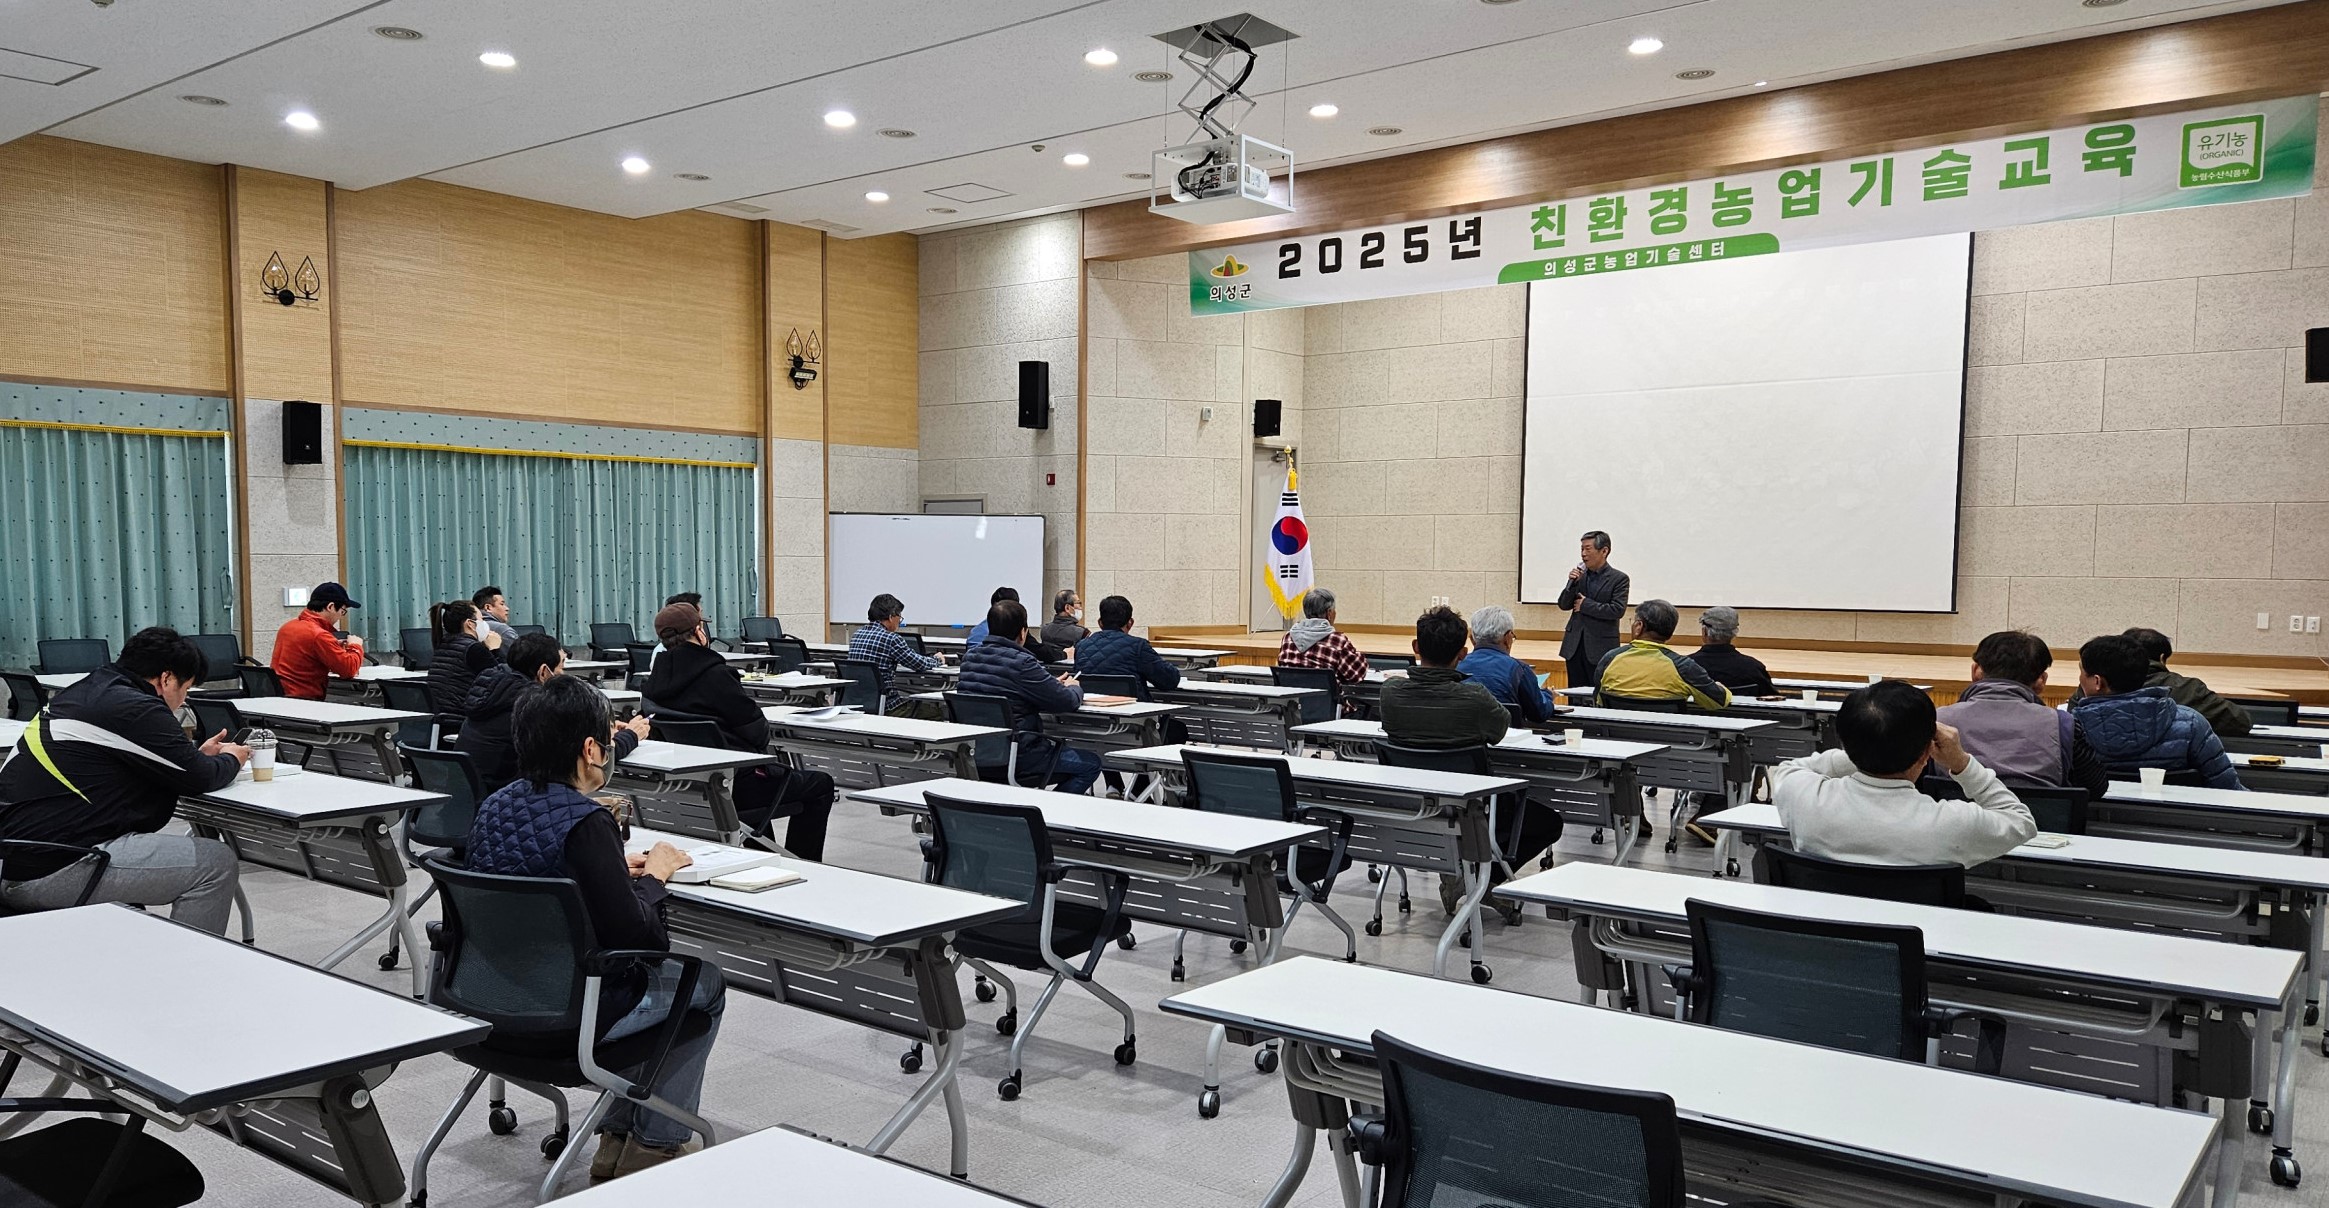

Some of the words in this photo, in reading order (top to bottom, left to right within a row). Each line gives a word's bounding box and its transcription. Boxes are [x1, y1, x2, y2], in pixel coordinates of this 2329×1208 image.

[2197, 132, 2248, 151] 유기농
[2199, 149, 2244, 160] (ORGANIC)
[1278, 216, 1482, 280] 2025년
[1530, 124, 2137, 250] 친환경농업기술교육
[1210, 284, 1252, 302] 의성군
